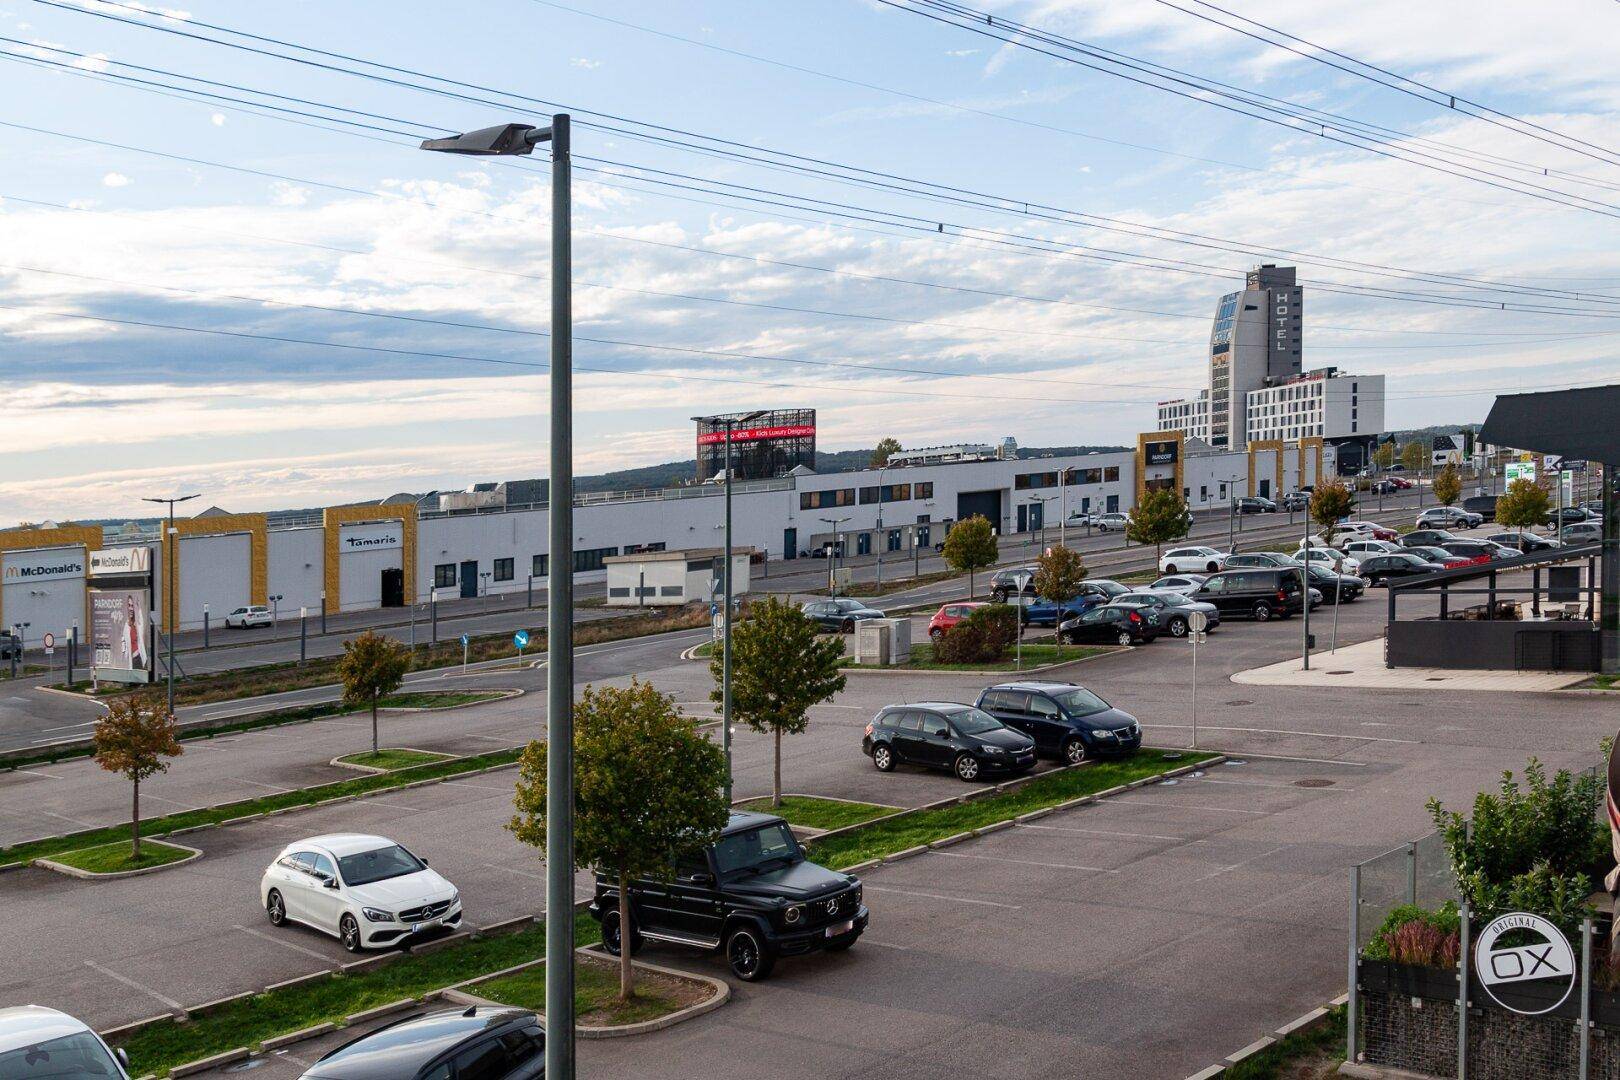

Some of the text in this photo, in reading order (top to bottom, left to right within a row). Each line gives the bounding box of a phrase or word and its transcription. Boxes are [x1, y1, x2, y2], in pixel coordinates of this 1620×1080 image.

[1276, 293, 1288, 350] HOTEL
[346, 535, 397, 547] Tamaris
[101, 556, 129, 568] McDonald's
[21, 563, 82, 577] McDonald's
[1492, 918, 1536, 934] ORIGINAL
[1491, 946, 1560, 979] OX
